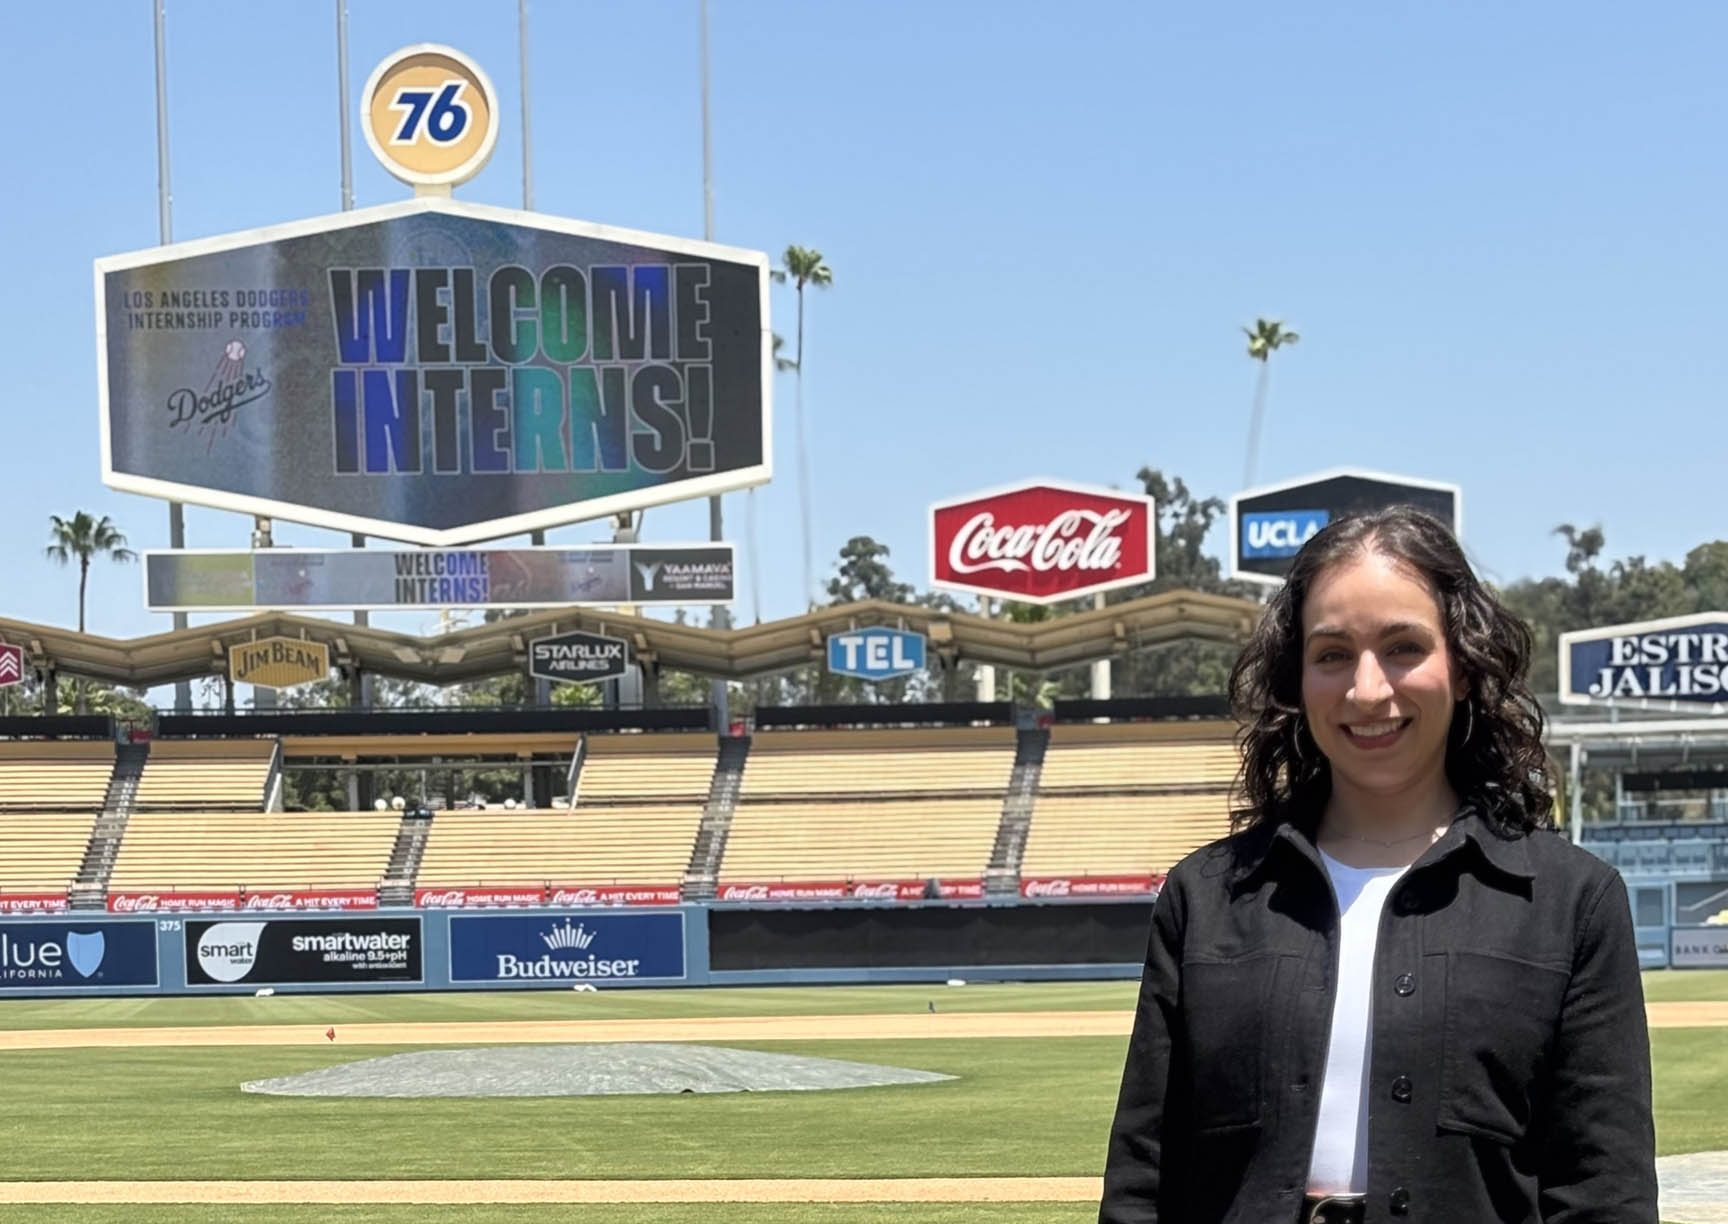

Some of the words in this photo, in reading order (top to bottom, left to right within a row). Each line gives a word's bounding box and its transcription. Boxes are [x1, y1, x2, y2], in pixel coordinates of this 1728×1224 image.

[394, 83, 468, 144] 76
[123, 290, 154, 309] LOS
[160, 290, 230, 309] ANGELES
[236, 289, 309, 308] DODGERS
[128, 312, 223, 330] INTERNSHIP
[229, 311, 307, 329] PROGRAM
[327, 264, 712, 364] WELCOME
[167, 367, 272, 428] Dodgers
[331, 363, 715, 475] INTERNS!
[948, 508, 1133, 574] Coca-Cola
[394, 553, 488, 576] WELCOME
[395, 577, 488, 603] INTERNS!
[237, 650, 270, 678] JIM
[272, 641, 320, 676] BEAM
[535, 643, 622, 660] STARLUX
[838, 635, 915, 671] TEL
[11, 900, 41, 909] EVERY
[42, 900, 67, 909] TIME
[187, 899, 206, 908] RUN
[207, 899, 235, 907] MAGIC
[304, 897, 320, 906] HIT
[320, 897, 351, 906] EVERY
[351, 896, 376, 905] TIME
[625, 891, 655, 901] EVERY
[656, 891, 679, 900] TIME
[159, 920, 182, 932] 375
[200, 942, 253, 958] smart
[292, 931, 410, 951] smartwater
[323, 951, 366, 962] alkaline
[366, 950, 408, 964] 9.5+pH
[497, 954, 639, 979] Budweiser
[0, 969, 63, 979] IFORNIA
